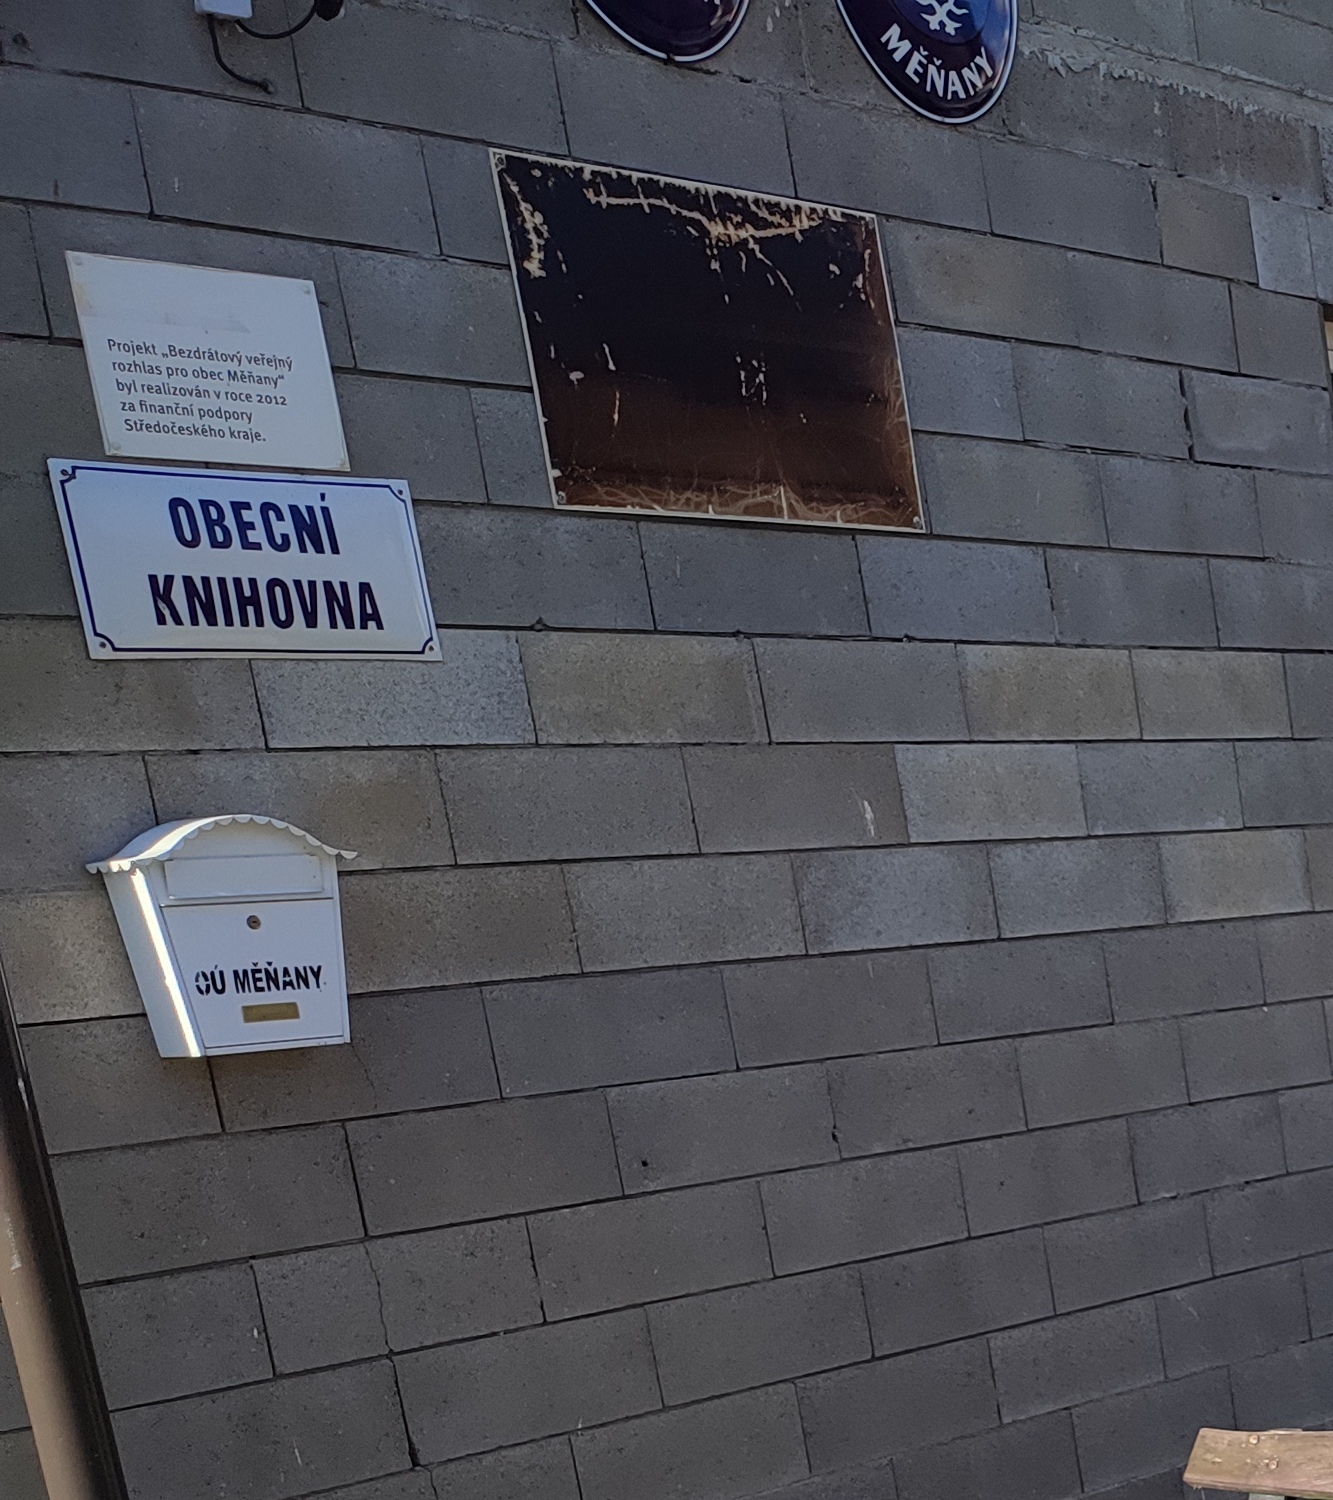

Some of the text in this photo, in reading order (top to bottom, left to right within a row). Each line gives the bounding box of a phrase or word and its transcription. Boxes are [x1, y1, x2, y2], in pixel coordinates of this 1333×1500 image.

[880, 23, 996, 100] MĚŇANY
[107, 338, 293, 373] Projekt „Bezdrátový veřejný
[112, 359, 285, 389] rozhlas pro obec Měňany“
[116, 377, 288, 407] byl realizován v roce 2012
[120, 400, 253, 425] za finanční podpory
[124, 418, 267, 444] Středočeského kraje.
[168, 493, 341, 555] OBECNÍ
[147, 573, 385, 631] KNIHOVNA
[194, 961, 323, 995] OÚ MĚŇANY
